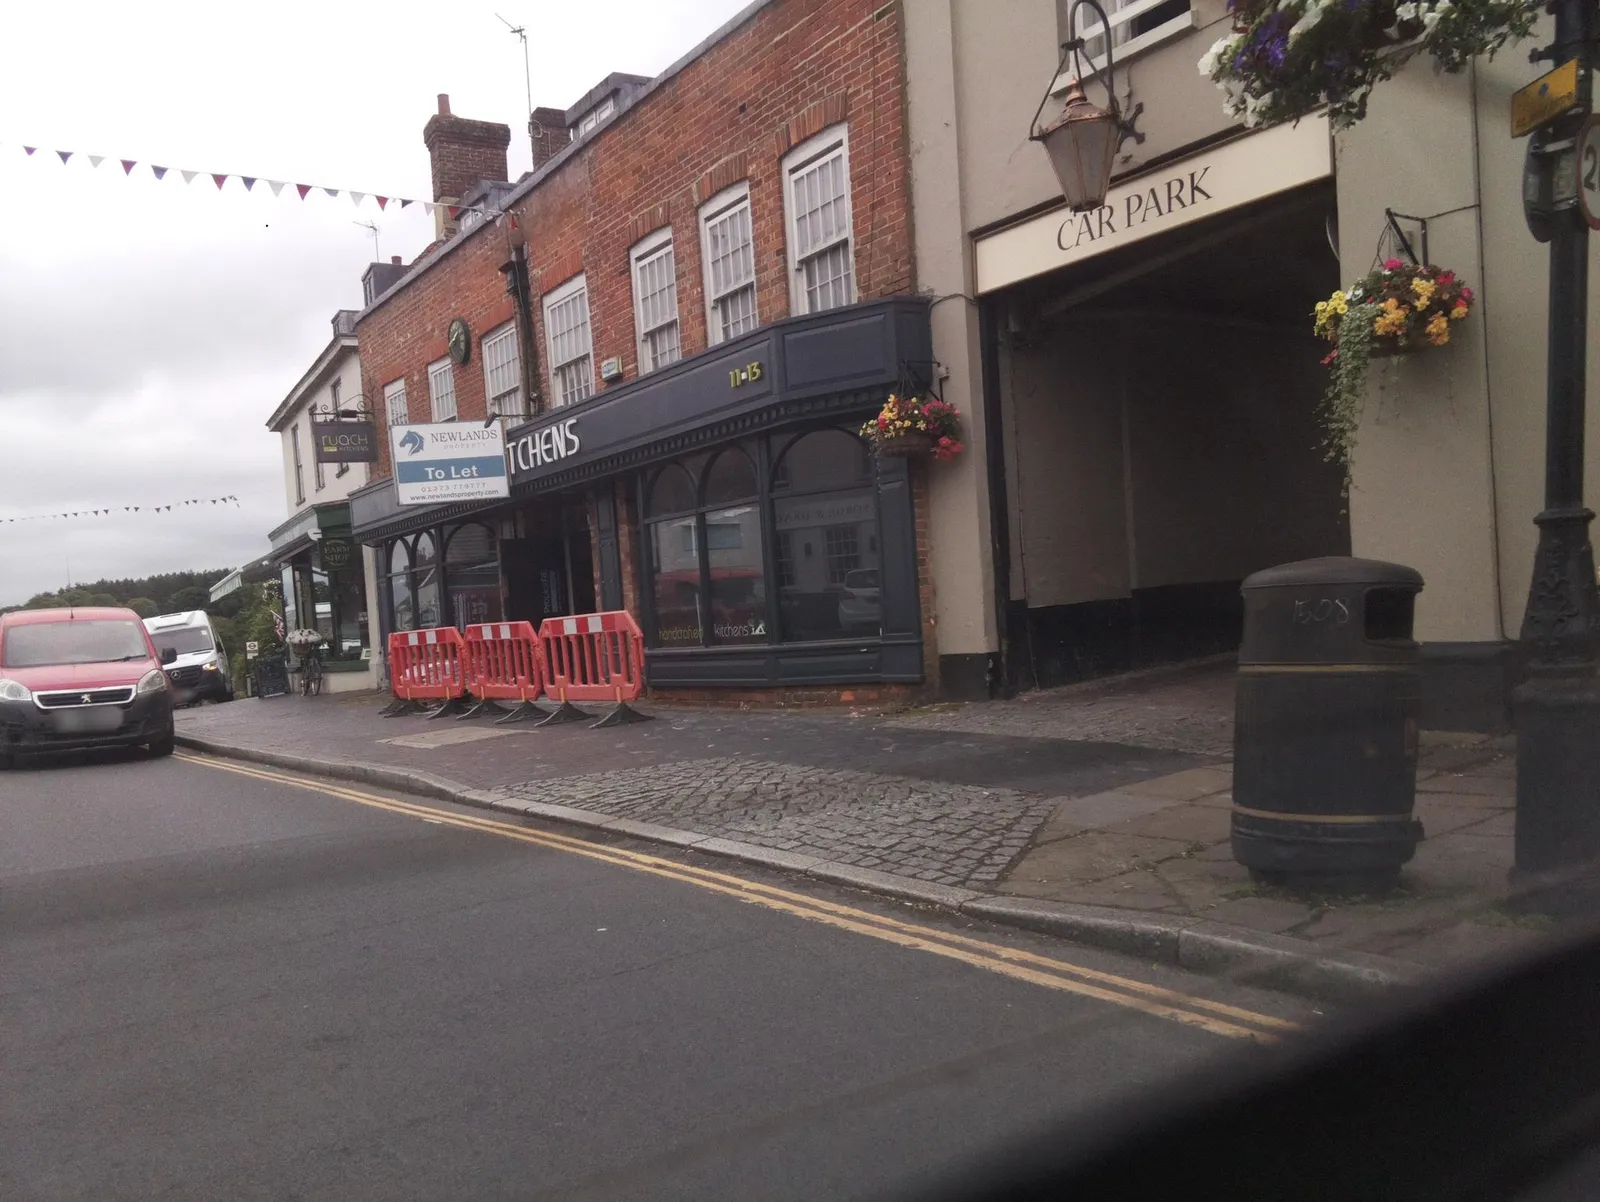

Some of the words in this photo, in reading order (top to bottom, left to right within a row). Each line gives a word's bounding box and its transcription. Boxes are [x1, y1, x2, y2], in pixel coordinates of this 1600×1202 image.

[1583, 143, 1600, 192] 2
[1057, 203, 1117, 251] CAR
[1124, 165, 1213, 229] PARK
[430, 429, 498, 444] NEWLANDS
[424, 467, 445, 480] To
[450, 465, 479, 478] Let
[409, 488, 499, 501] www.newlandsproperty.com
[713, 623, 749, 638] kitchens
